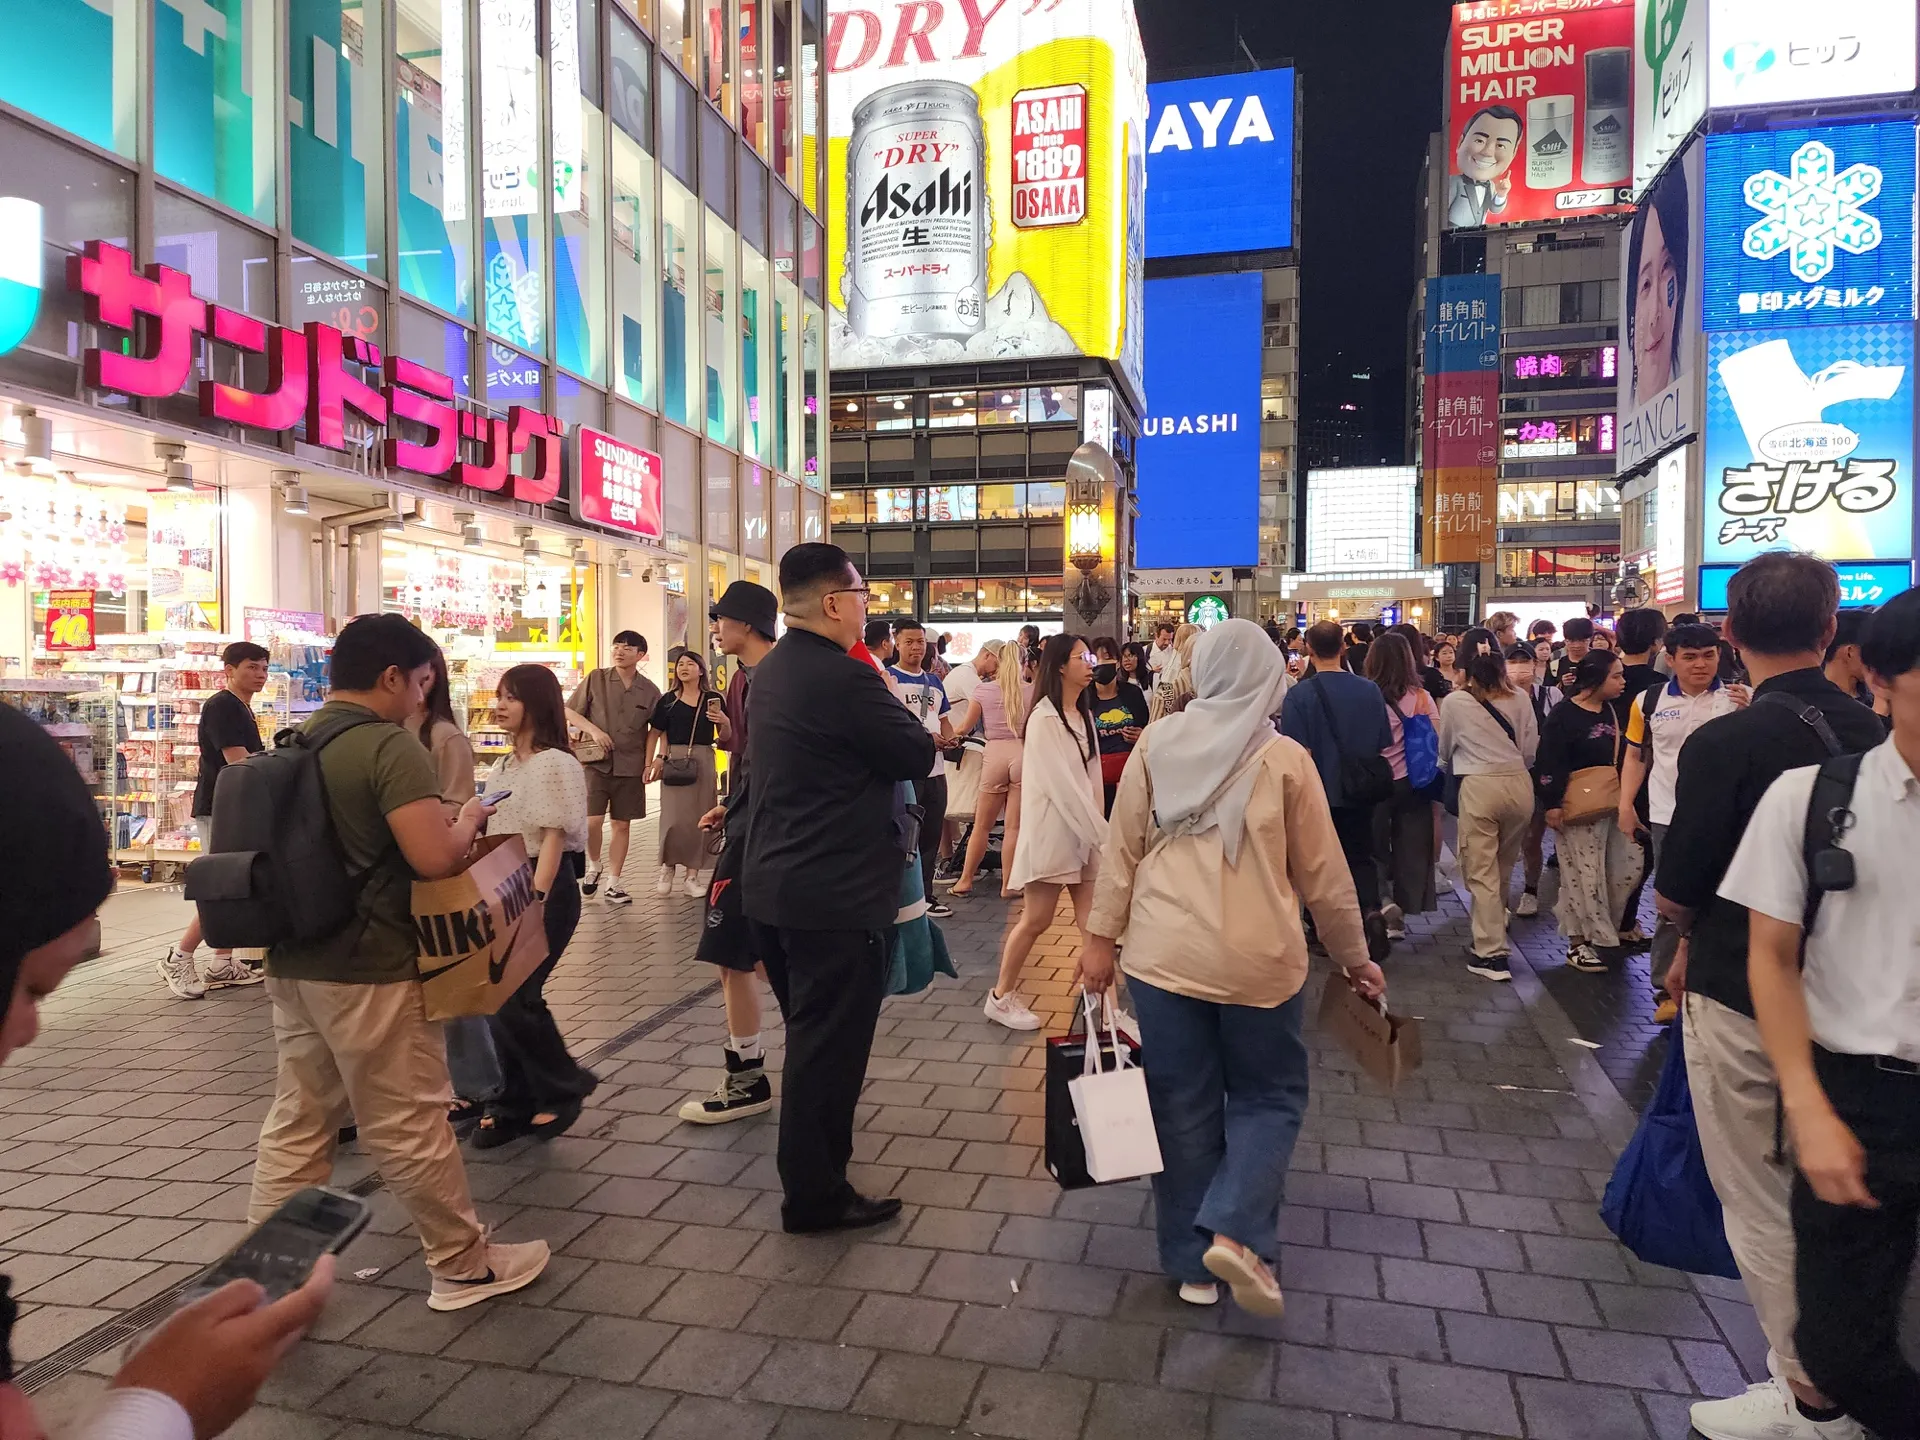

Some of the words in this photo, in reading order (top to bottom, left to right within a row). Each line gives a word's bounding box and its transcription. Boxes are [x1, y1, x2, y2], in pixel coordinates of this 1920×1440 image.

[1461, 18, 1565, 51] SUPER
[1460, 44, 1575, 77] MILLION
[1460, 75, 1537, 104] HAIR
[1662, 41, 1694, 119] ピップ
[1015, 96, 1082, 136] ASAHI
[1149, 95, 1275, 154] AYA
[896, 130, 938, 143] SUPER
[1033, 133, 1065, 149] since
[1541, 142, 1562, 152] SMH
[1015, 144, 1082, 181] 1889
[861, 167, 971, 227] Asahi
[1016, 183, 1081, 220] OSAKA
[1562, 193, 1602, 206] ルアン
[902, 226, 930, 247] 生
[884, 263, 950, 280] スーパードライ
[1440, 299, 1487, 322] 龍角散
[67, 240, 563, 504] サンドラッグ
[1515, 354, 1562, 378] 焼肉
[1438, 395, 1485, 418] 龍角散
[1142, 413, 1238, 437] UBASHI
[1519, 420, 1558, 440] 力丸
[1622, 388, 1687, 466] FANCL
[1768, 436, 1829, 449] 雪印北海道
[1831, 436, 1851, 446] 100
[594, 438, 650, 474] SUNDRUG
[1718, 457, 1897, 516] さける
[1435, 491, 1483, 513] 龍角散
[1718, 517, 1787, 545] チーズ
[1855, 571, 1876, 581] Life.
[1840, 586, 1883, 600] ミルク
[50, 614, 88, 647] 10
[905, 693, 935, 706] Levs
[1655, 709, 1680, 719] MCGI
[412, 899, 496, 957] NIKE
